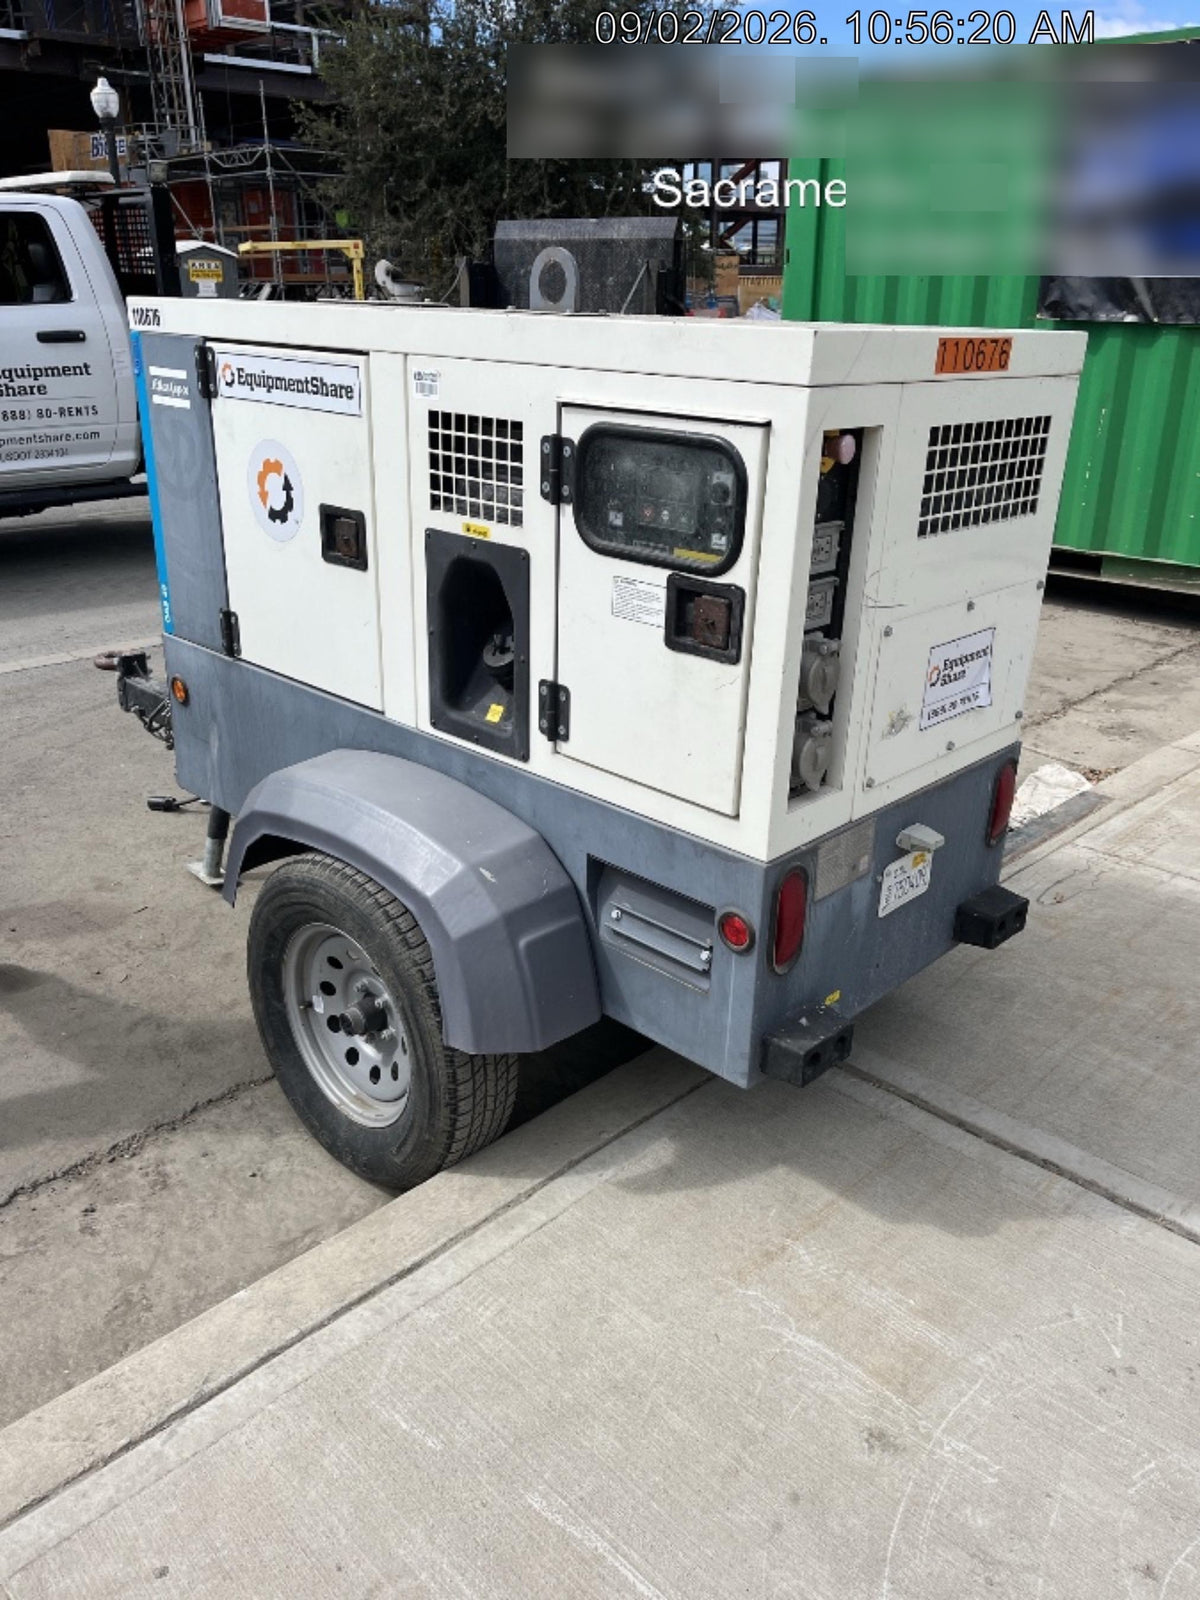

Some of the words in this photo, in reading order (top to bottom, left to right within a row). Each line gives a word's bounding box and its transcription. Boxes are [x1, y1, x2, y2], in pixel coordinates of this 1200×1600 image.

[940, 339, 1009, 372] 110676
[236, 367, 355, 400] EquipmentShare
[36, 405, 98, 418] 80-RENTS
